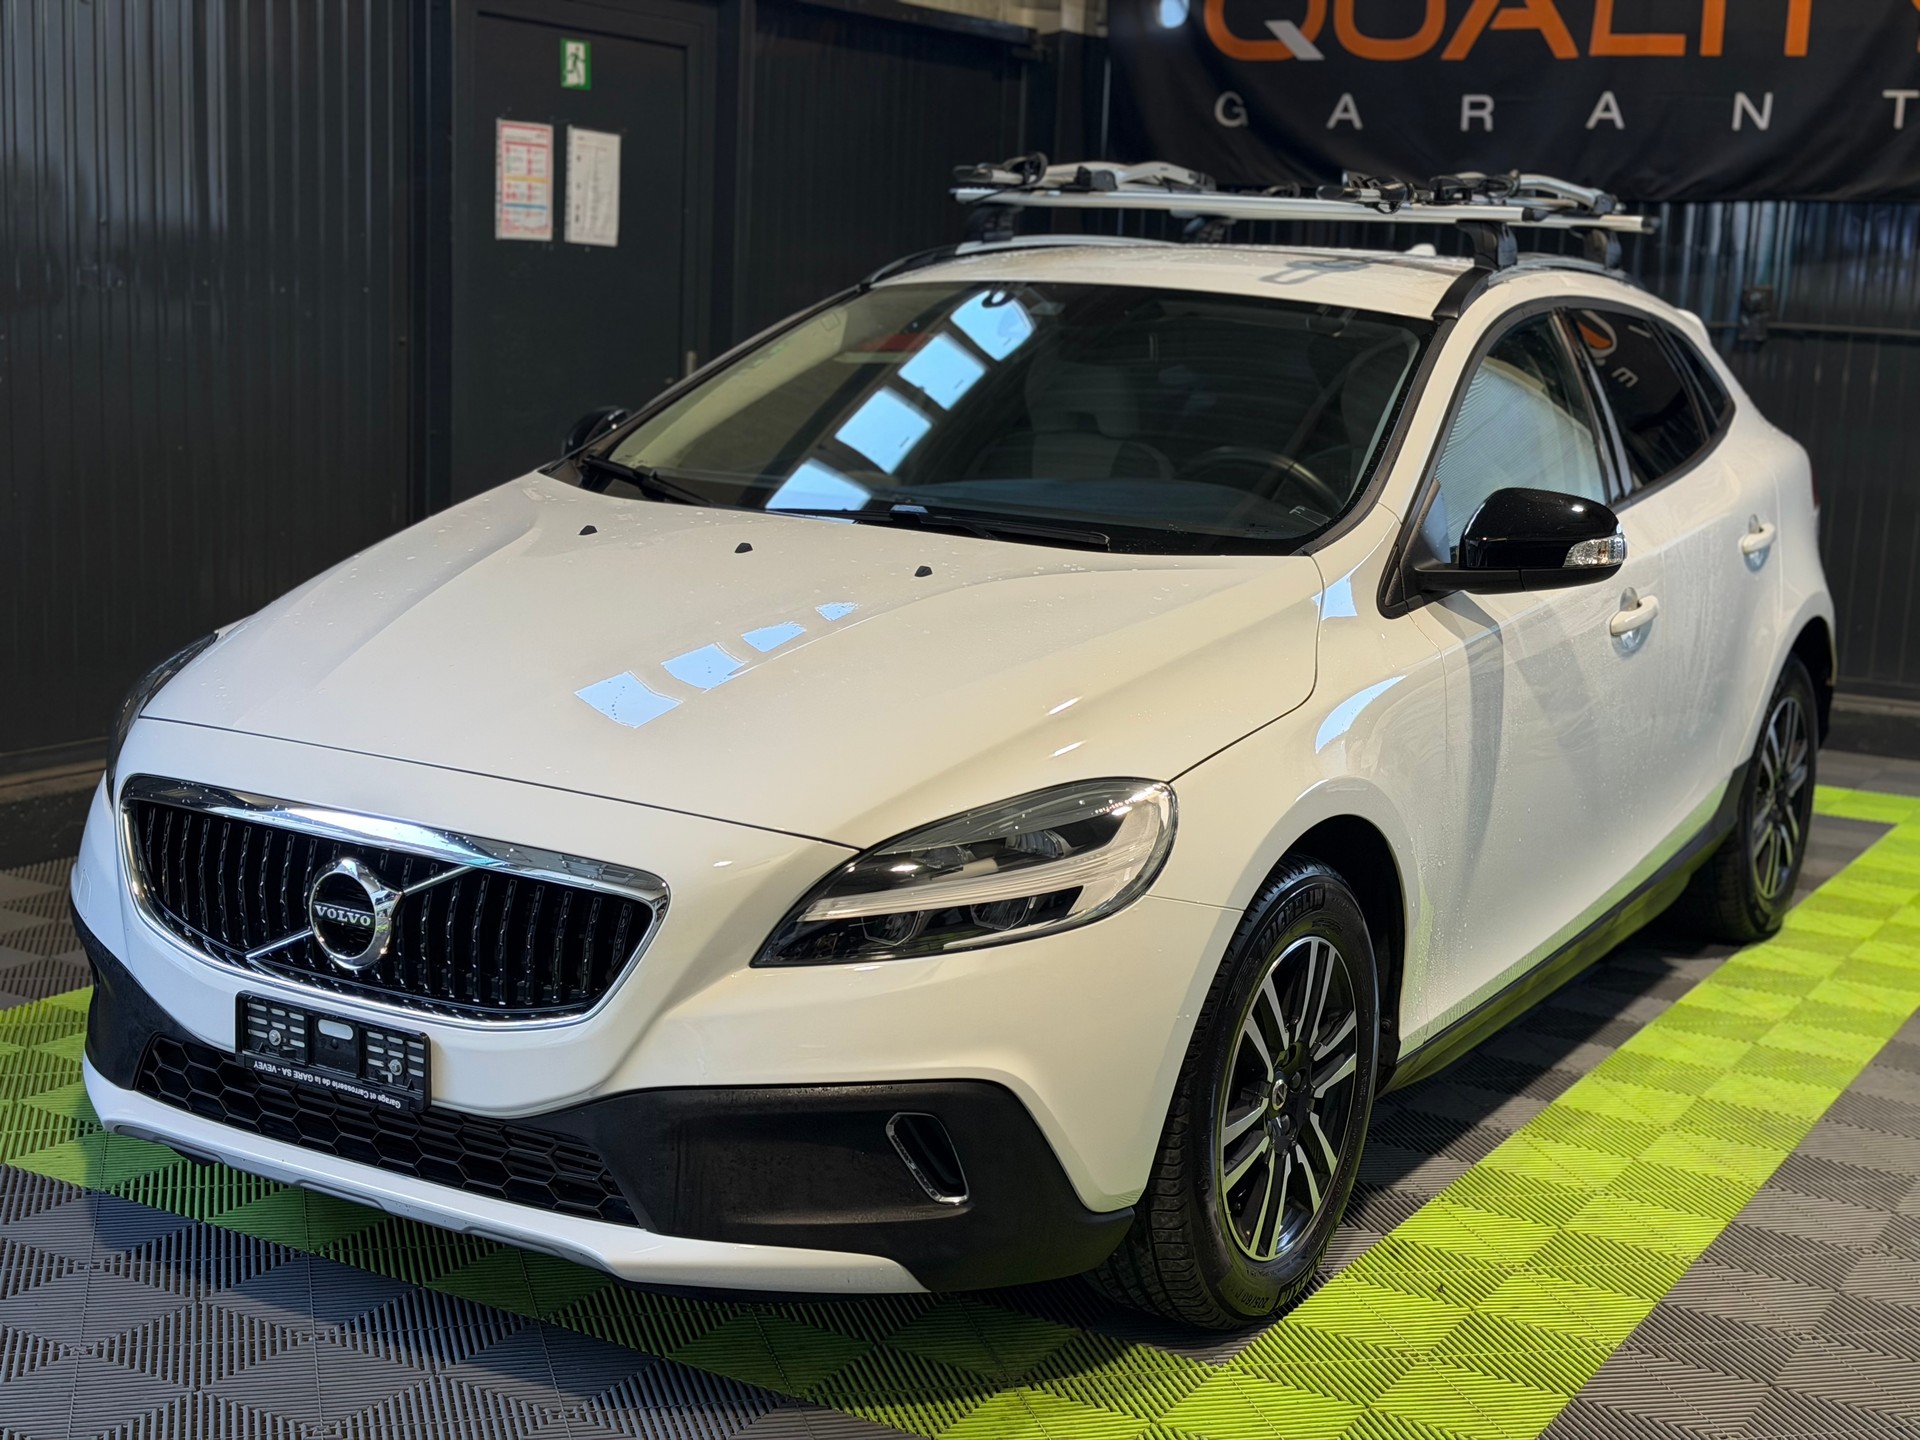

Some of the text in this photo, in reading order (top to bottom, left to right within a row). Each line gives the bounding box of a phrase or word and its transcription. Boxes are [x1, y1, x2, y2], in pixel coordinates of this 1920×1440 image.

[314, 905, 371, 926] VOLVO
[253, 1060, 278, 1074] VEVEY
[282, 1067, 292, 1076] SA
[293, 1070, 314, 1083] GARE
[314, 1075, 321, 1085] la
[322, 1078, 331, 1087] de
[332, 1080, 369, 1099] Carrosserie
[369, 1092, 377, 1100] et
[377, 1094, 401, 1109] Garage
